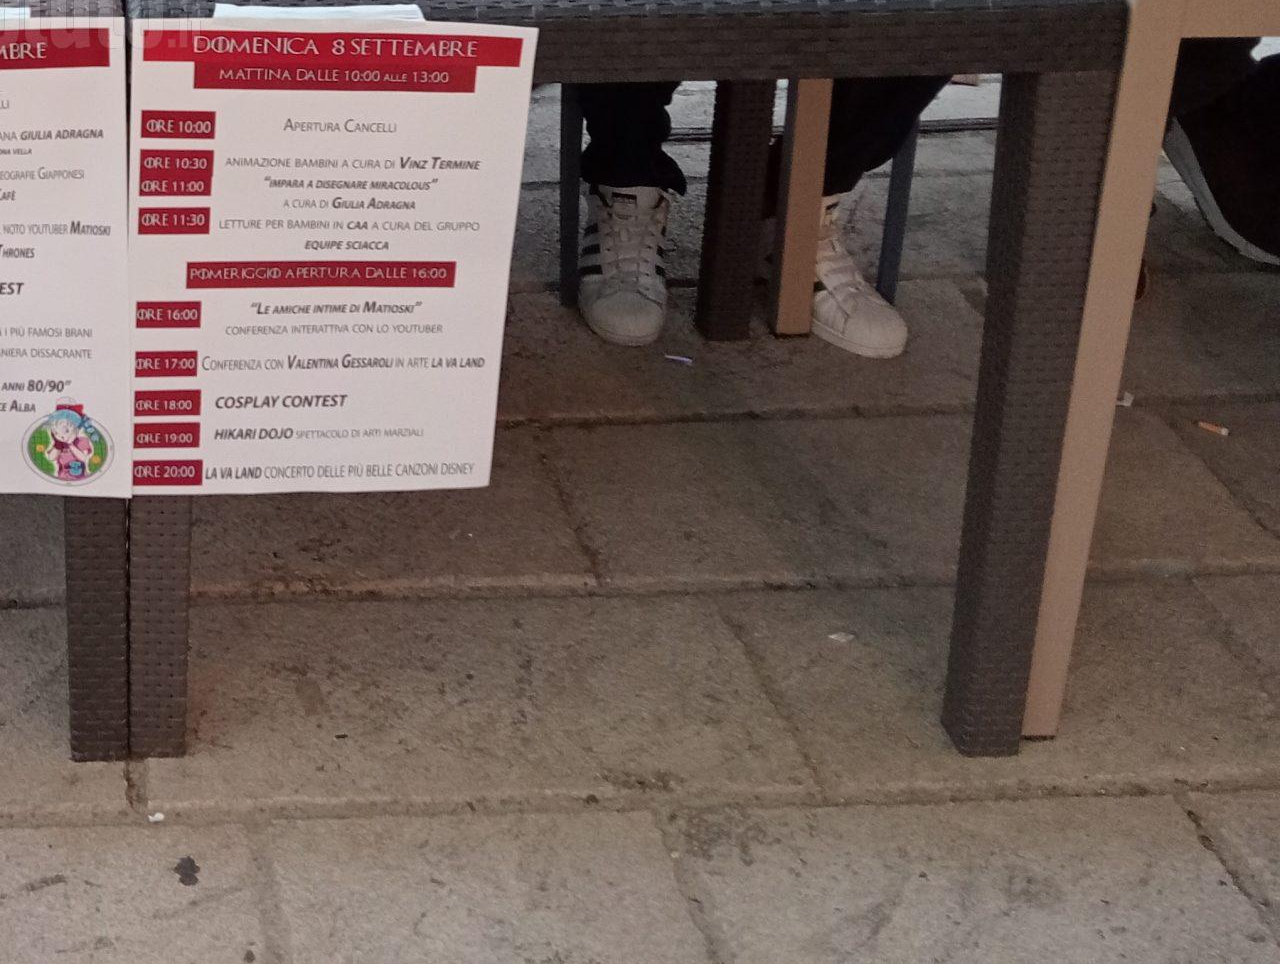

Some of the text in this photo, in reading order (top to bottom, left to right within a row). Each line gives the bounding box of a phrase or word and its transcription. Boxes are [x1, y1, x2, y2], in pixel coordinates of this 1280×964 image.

[194, 36, 478, 58] DOMENICA 8 SETTEMBRE
[219, 68, 449, 83] MATTINA DALLE 10:00 ALLE 13:00
[146, 119, 211, 134] ORE 10:00
[144, 157, 207, 169] ORE 10:30
[141, 180, 204, 192] ORE 11:00
[141, 214, 205, 226] ORE 11:30
[304, 240, 389, 250] EQUIPE SCIACCA
[190, 267, 448, 280] POMERIGGIO APERTURA DALLE 16:00
[137, 308, 198, 321] ORE 16:00
[136, 358, 195, 370] ORE 17:00
[136, 400, 192, 411] ORE 18:00
[215, 394, 348, 409] COSPLAY CONTEST
[137, 433, 193, 444] ORE 19:00
[213, 428, 256, 440] HIKARI
[258, 428, 294, 440] DOJO
[134, 465, 195, 478] ORE 20:00
